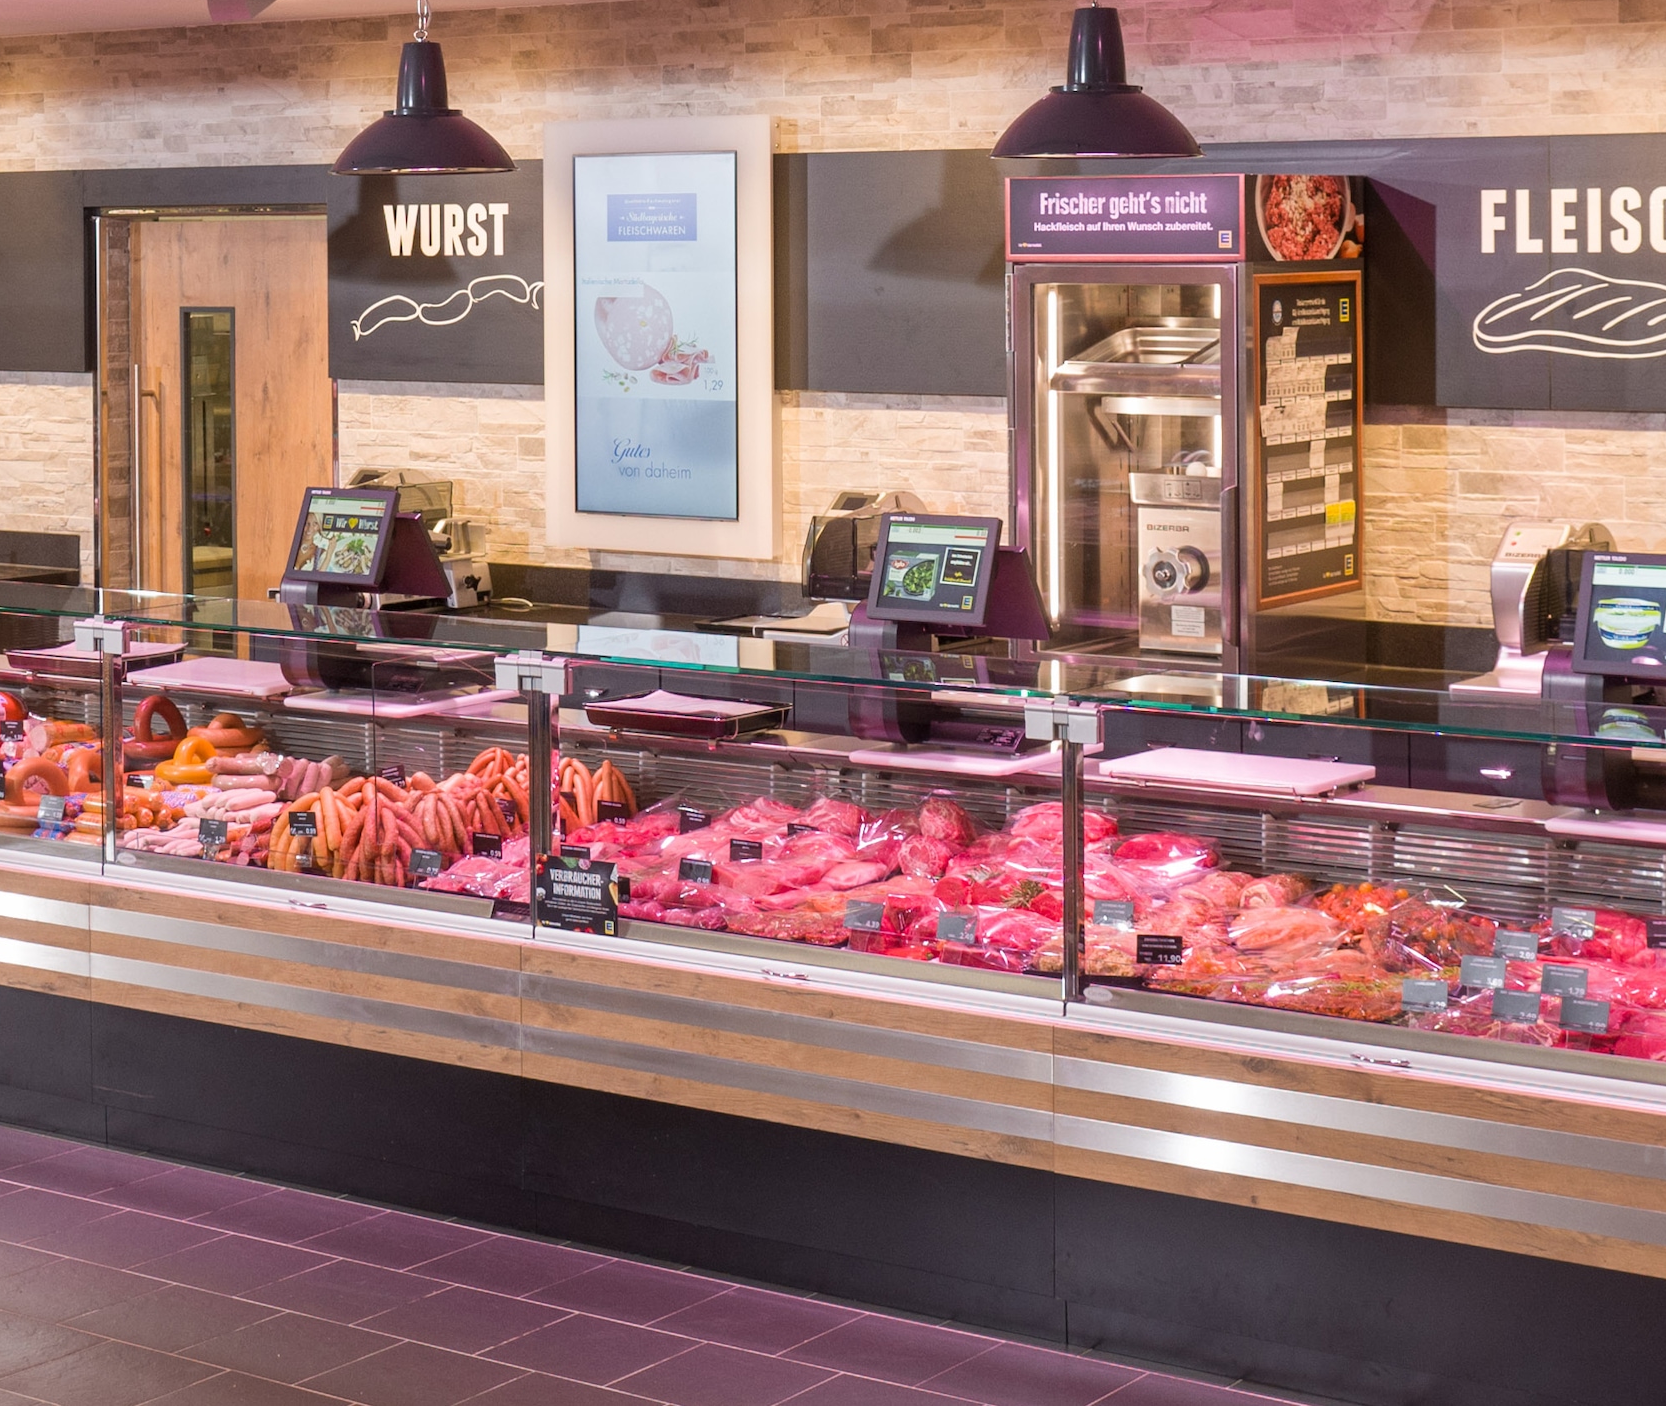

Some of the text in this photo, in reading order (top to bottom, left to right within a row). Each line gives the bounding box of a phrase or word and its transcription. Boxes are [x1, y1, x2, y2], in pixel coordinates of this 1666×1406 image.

[1040, 193, 1105, 215] Frischer
[1165, 191, 1207, 215] nicht
[383, 202, 509, 257] WURST
[618, 225, 686, 236] FLEISCHWAREN
[1034, 222, 1213, 231] Hackfleisch auf Ihren Wunsch zubereitet.
[703, 379, 724, 392] 1,29
[611, 437, 651, 464] Gutes
[619, 461, 691, 479] von daheim
[1146, 524, 1190, 532] BIZERBA
[549, 868, 604, 887] VERBRAUCHER-
[553, 882, 602, 901] INFORMATION
[1157, 954, 1181, 963] 11.90
